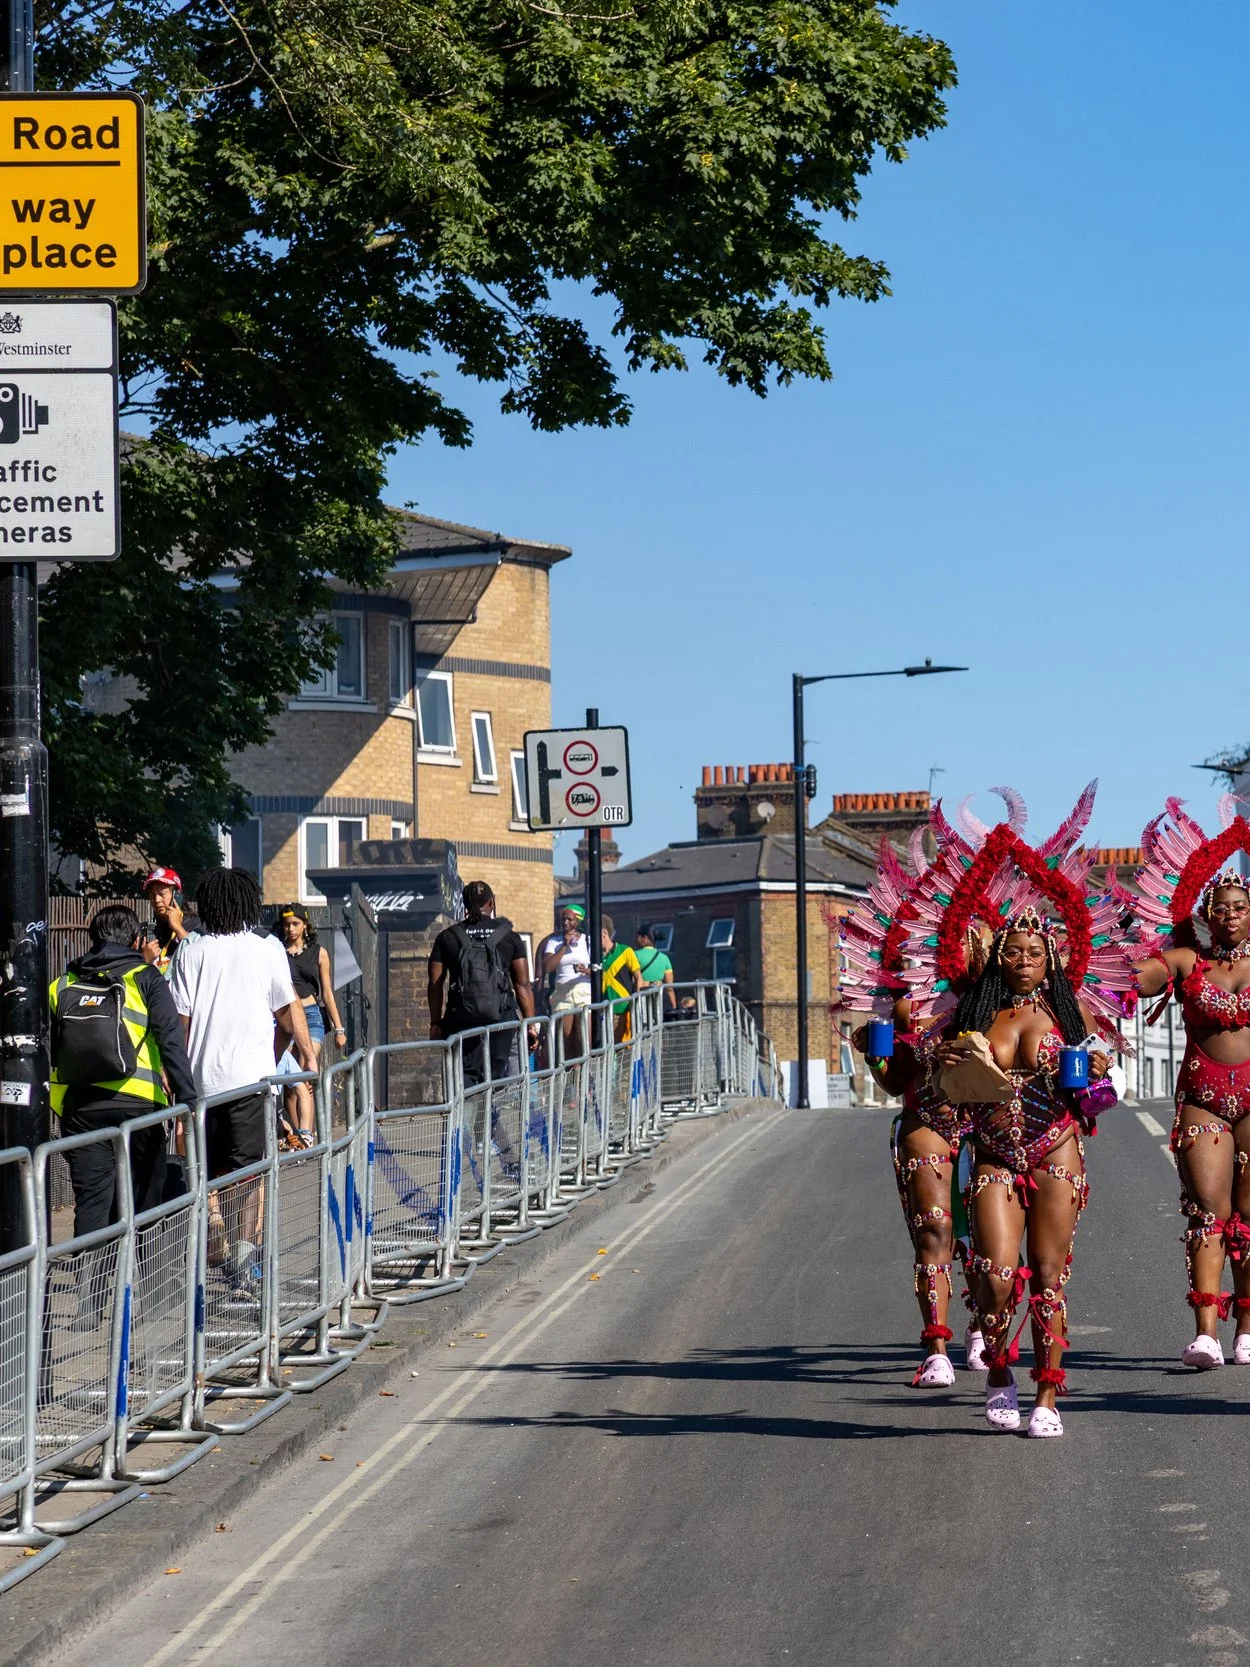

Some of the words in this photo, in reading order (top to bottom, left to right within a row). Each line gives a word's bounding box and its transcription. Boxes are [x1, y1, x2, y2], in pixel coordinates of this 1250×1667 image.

[14, 116, 119, 150] Road
[11, 198, 96, 230] way
[3, 235, 118, 275] place
[603, 806, 624, 821] OTR
[78, 995, 106, 1007] CAT
